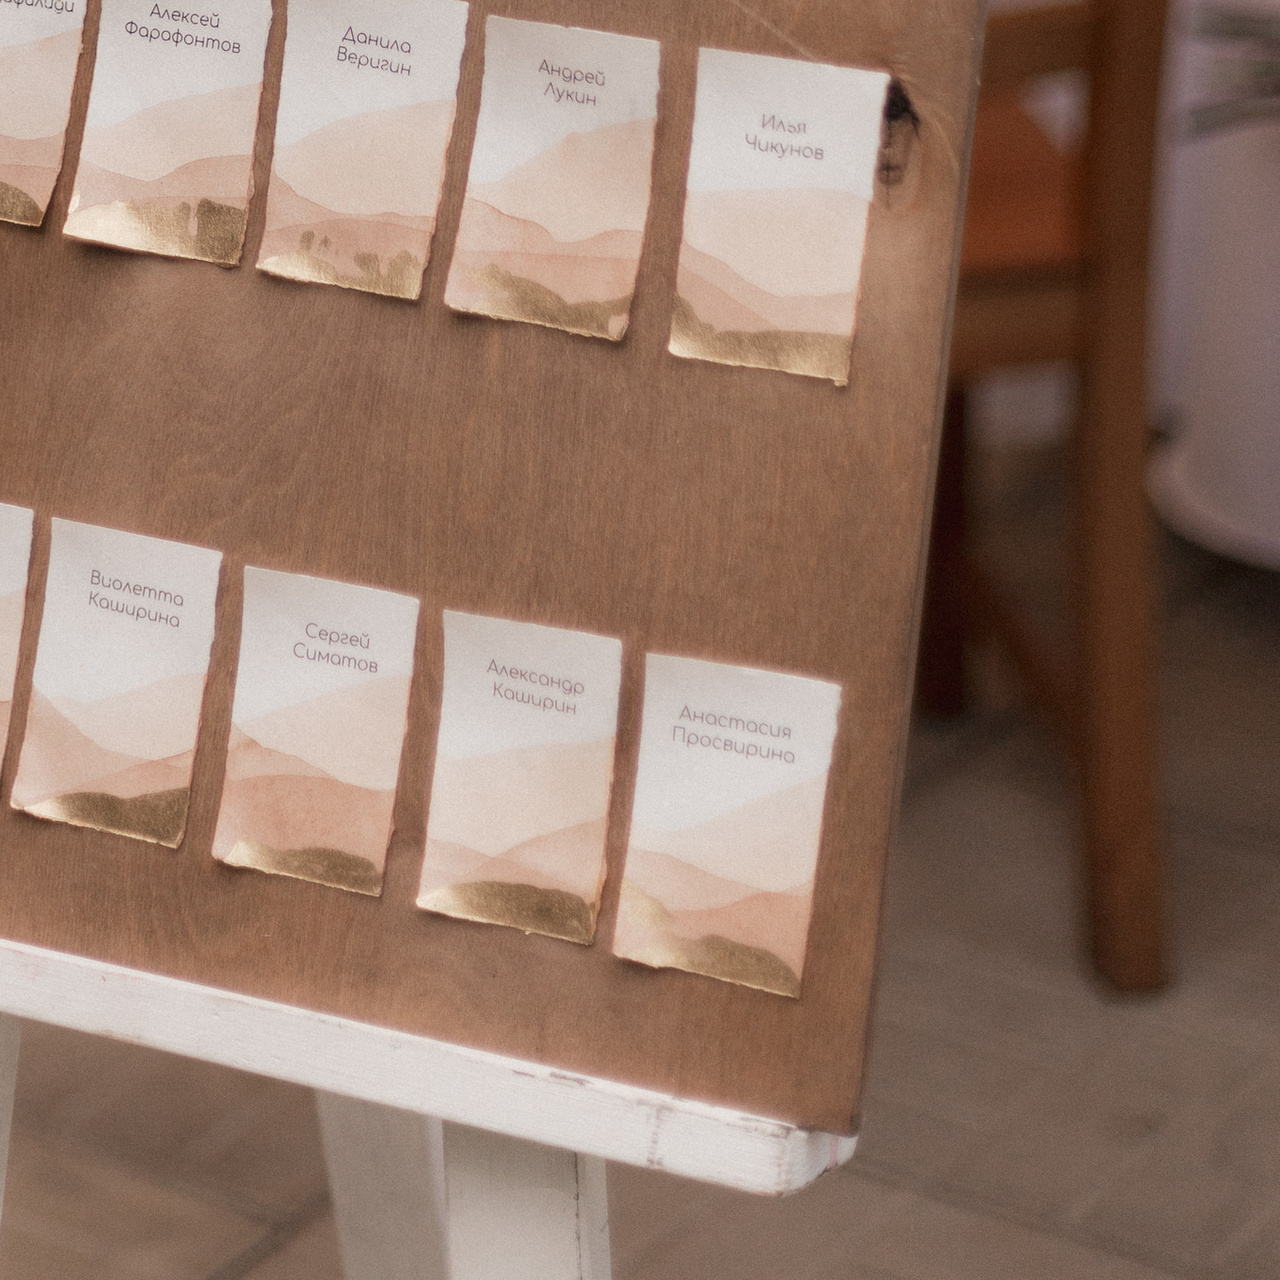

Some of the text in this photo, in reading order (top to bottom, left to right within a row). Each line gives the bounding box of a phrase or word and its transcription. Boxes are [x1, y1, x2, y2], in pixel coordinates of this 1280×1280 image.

[149, 2, 221, 30] Алексей
[124, 19, 242, 55] Фарафонтов
[341, 25, 413, 55] Данила
[336, 44, 412, 76] Веригин
[538, 58, 606, 88] Андрей
[543, 81, 598, 106] Лукин
[760, 113, 808, 134] Илья
[744, 133, 825, 162] Чикунов
[89, 568, 185, 608] Виолетта
[88, 590, 181, 629] Каширина
[304, 621, 371, 650] Сергей
[292, 641, 379, 674] Симатов
[486, 658, 586, 696] Александр
[492, 681, 577, 715] Каширин
[678, 704, 793, 740] Анастасия
[671, 724, 796, 765] Просвирина
